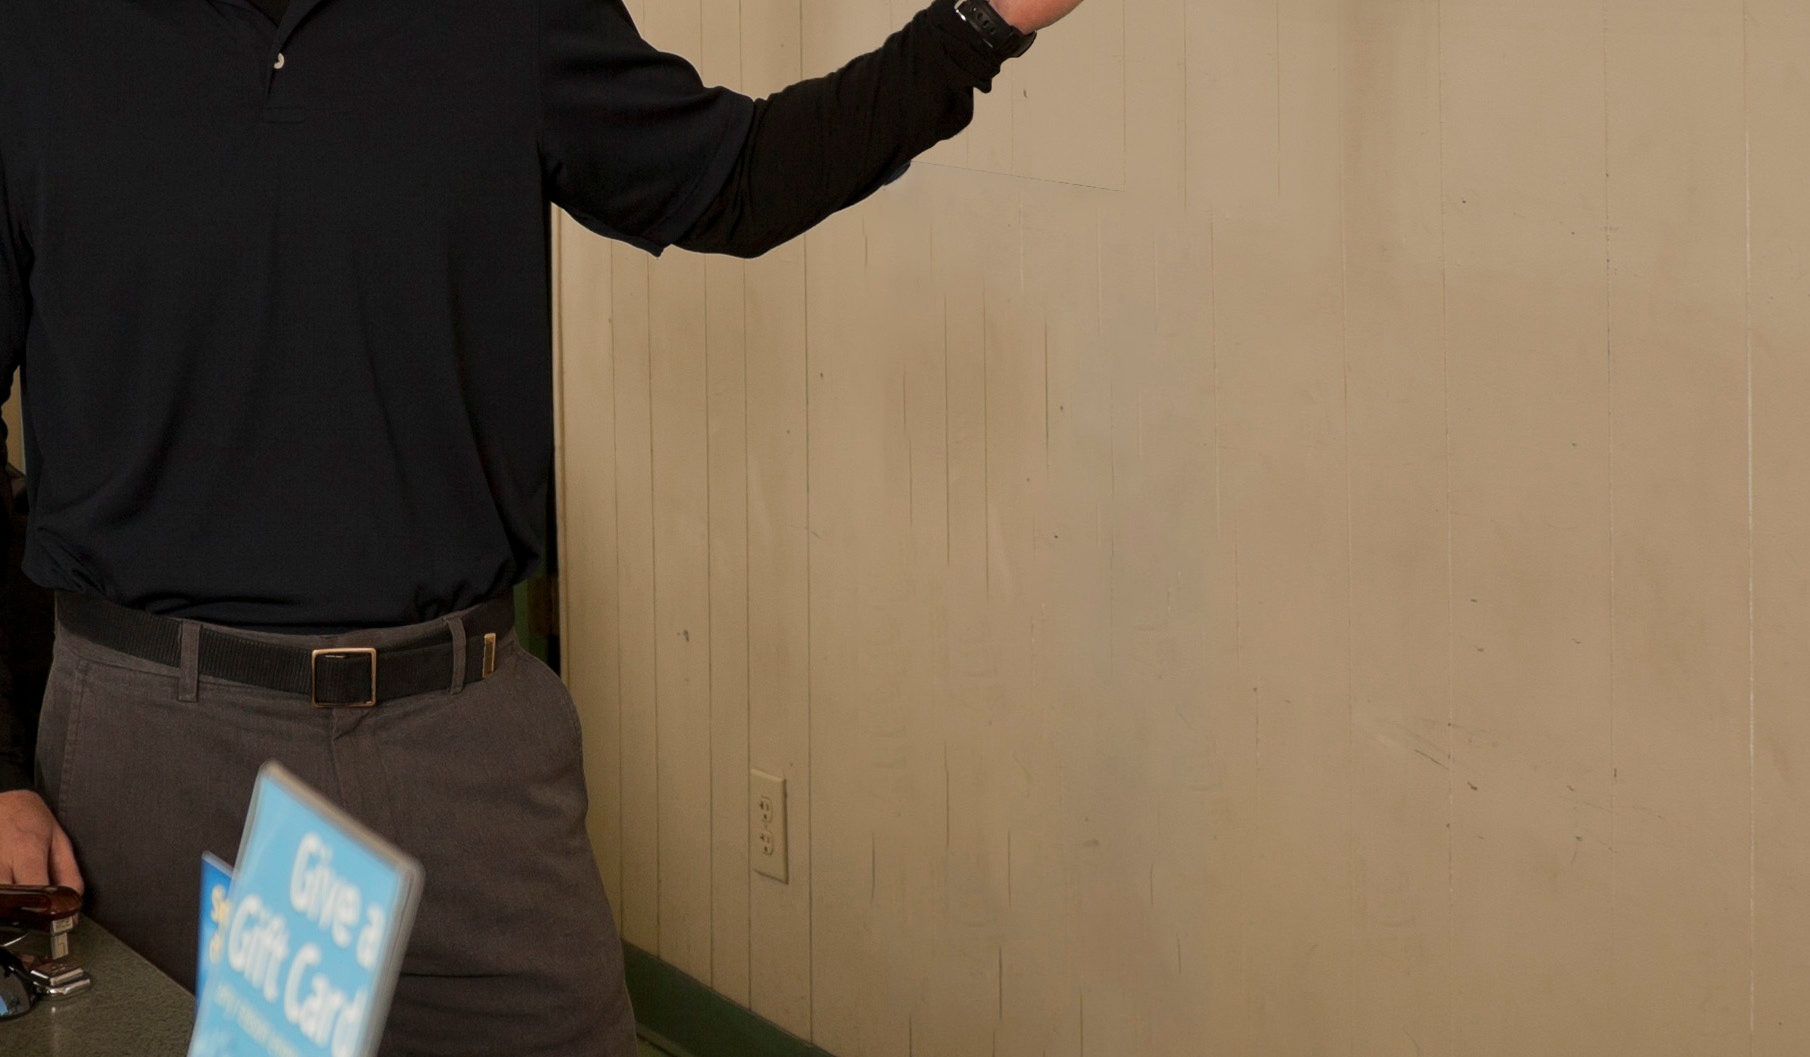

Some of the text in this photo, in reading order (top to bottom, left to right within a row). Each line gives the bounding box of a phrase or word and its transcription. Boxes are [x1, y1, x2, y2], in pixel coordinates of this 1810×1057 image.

[228, 894, 288, 1002] Gift
[290, 832, 385, 970] Give a
